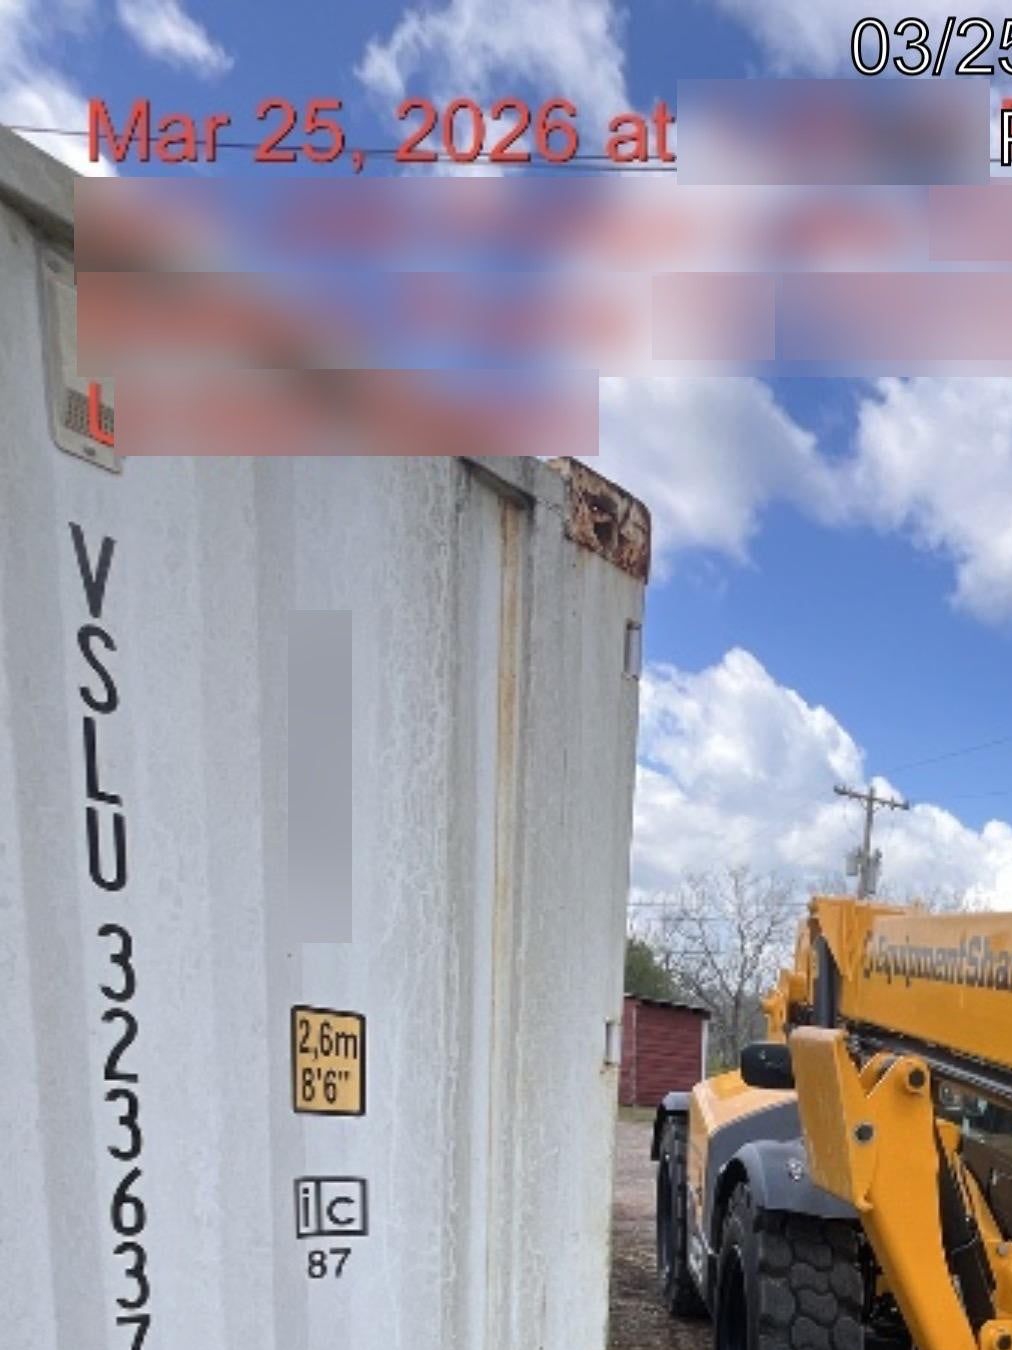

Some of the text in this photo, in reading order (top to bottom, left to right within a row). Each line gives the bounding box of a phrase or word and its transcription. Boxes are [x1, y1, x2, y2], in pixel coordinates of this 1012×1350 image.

[69, 521, 128, 893] VSLU
[299, 1018, 359, 1060] 2,6m
[307, 1247, 352, 1280] 87
